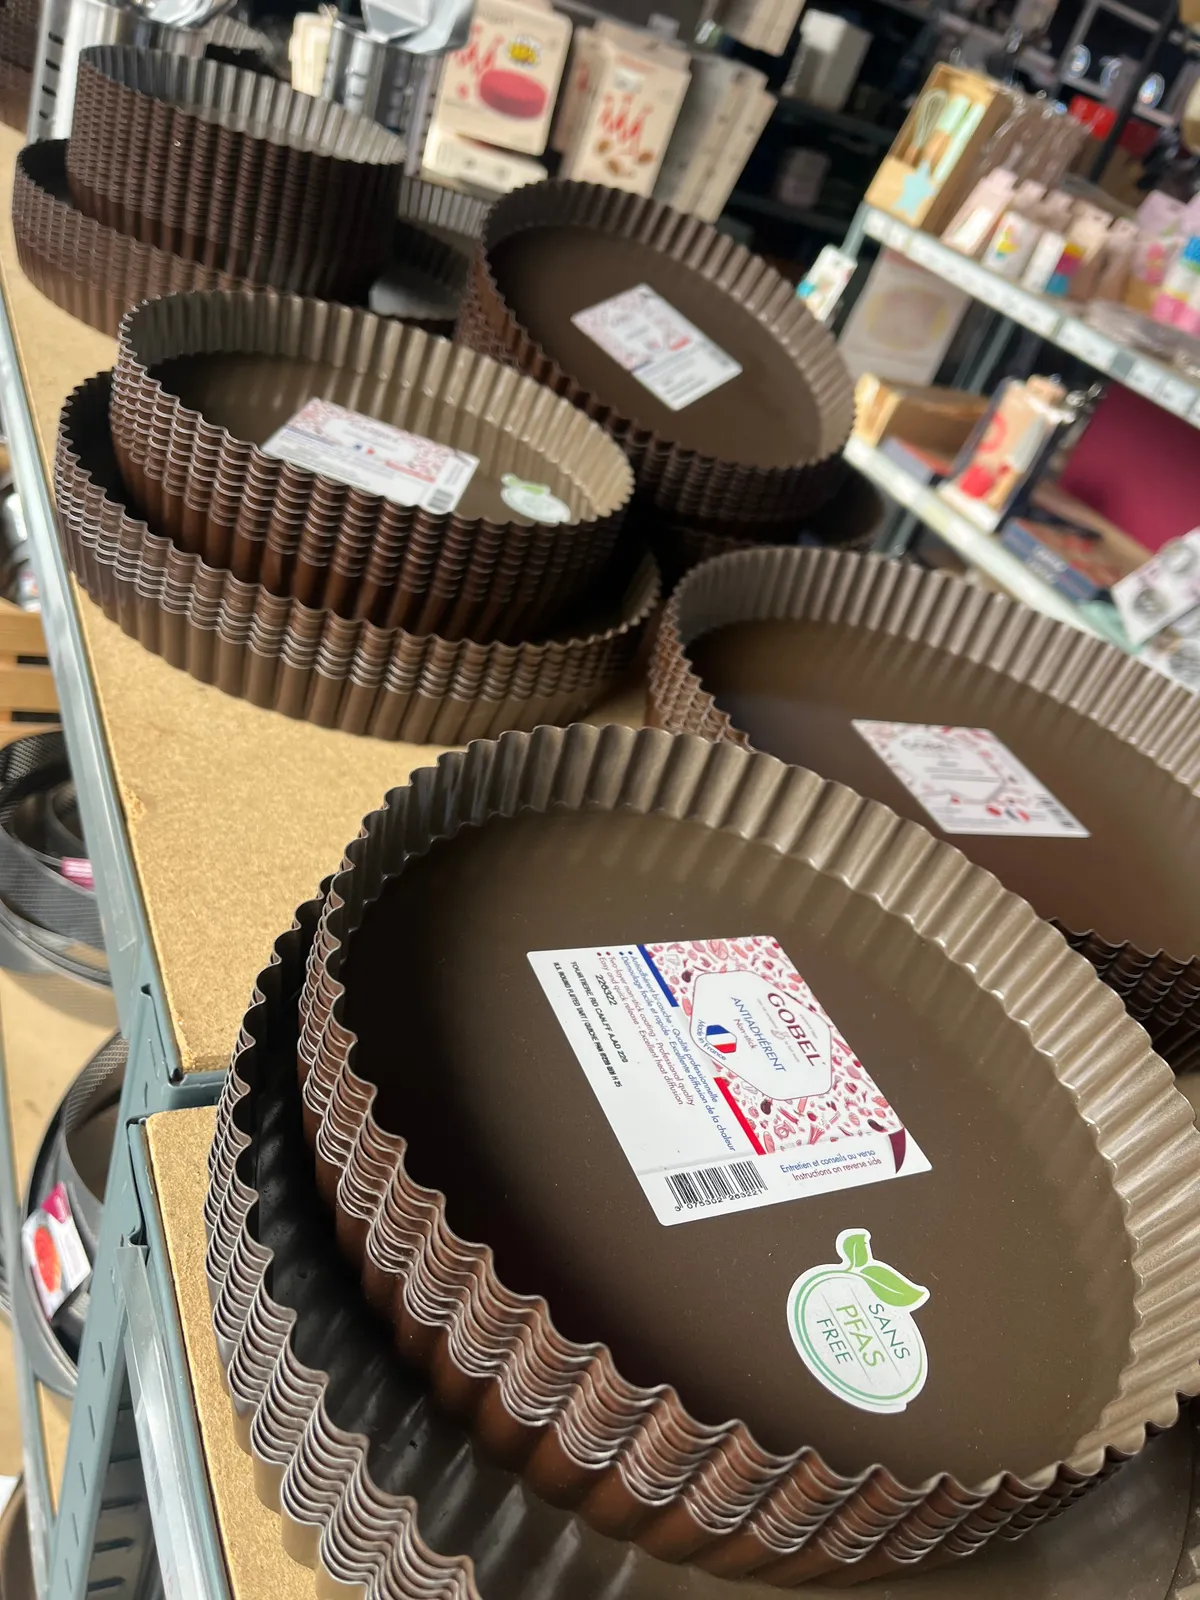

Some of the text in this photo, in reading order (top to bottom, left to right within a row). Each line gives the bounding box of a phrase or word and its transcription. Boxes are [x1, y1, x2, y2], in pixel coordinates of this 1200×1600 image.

[570, 961, 593, 996] TOURTIERE
[598, 956, 609, 970] Easy
[606, 971, 619, 984] and
[612, 984, 628, 1001] quick
[623, 1002, 639, 1024] release
[630, 955, 655, 993] Antiadhérent
[651, 993, 671, 1023] bi-couche
[671, 1028, 690, 1052] Qualité
[683, 1053, 718, 1102] professionnelle
[608, 956, 627, 984] Two-layer
[623, 985, 644, 1012] non-stick
[639, 1013, 656, 1037] coating
[655, 1042, 684, 1081] Professional
[677, 1082, 695, 1105] quality
[638, 1029, 658, 1058] Excellent
[697, 1018, 705, 1036] Made
[703, 1042, 726, 1060] France
[730, 997, 786, 1071] ANTIADHÉRENT
[733, 1018, 757, 1049] Non-stick
[767, 992, 821, 1066] GOBEL
[620, 956, 642, 989] Démoulage
[639, 990, 653, 1007] facile
[653, 1015, 670, 1036] rapide
[668, 1041, 690, 1073] Excellente
[687, 1074, 707, 1103] diffusion
[705, 1104, 714, 1114] de
[711, 1115, 719, 1123] la
[716, 1124, 735, 1151] chaleur
[654, 1058, 667, 1074] heat
[663, 1075, 683, 1104] diffusion
[780, 1160, 810, 1174] Entretien
[820, 1154, 847, 1165] conseils
[857, 1149, 875, 1158] verso
[792, 1166, 831, 1181] Instructions
[842, 1161, 867, 1173] reverse
[867, 1158, 882, 1167] side
[687, 1197, 723, 1210] 075302
[729, 1189, 763, 1201] 263221
[816, 1318, 853, 1364] FREE
[836, 1304, 885, 1367] PFAS
[868, 1304, 910, 1359] SANS
